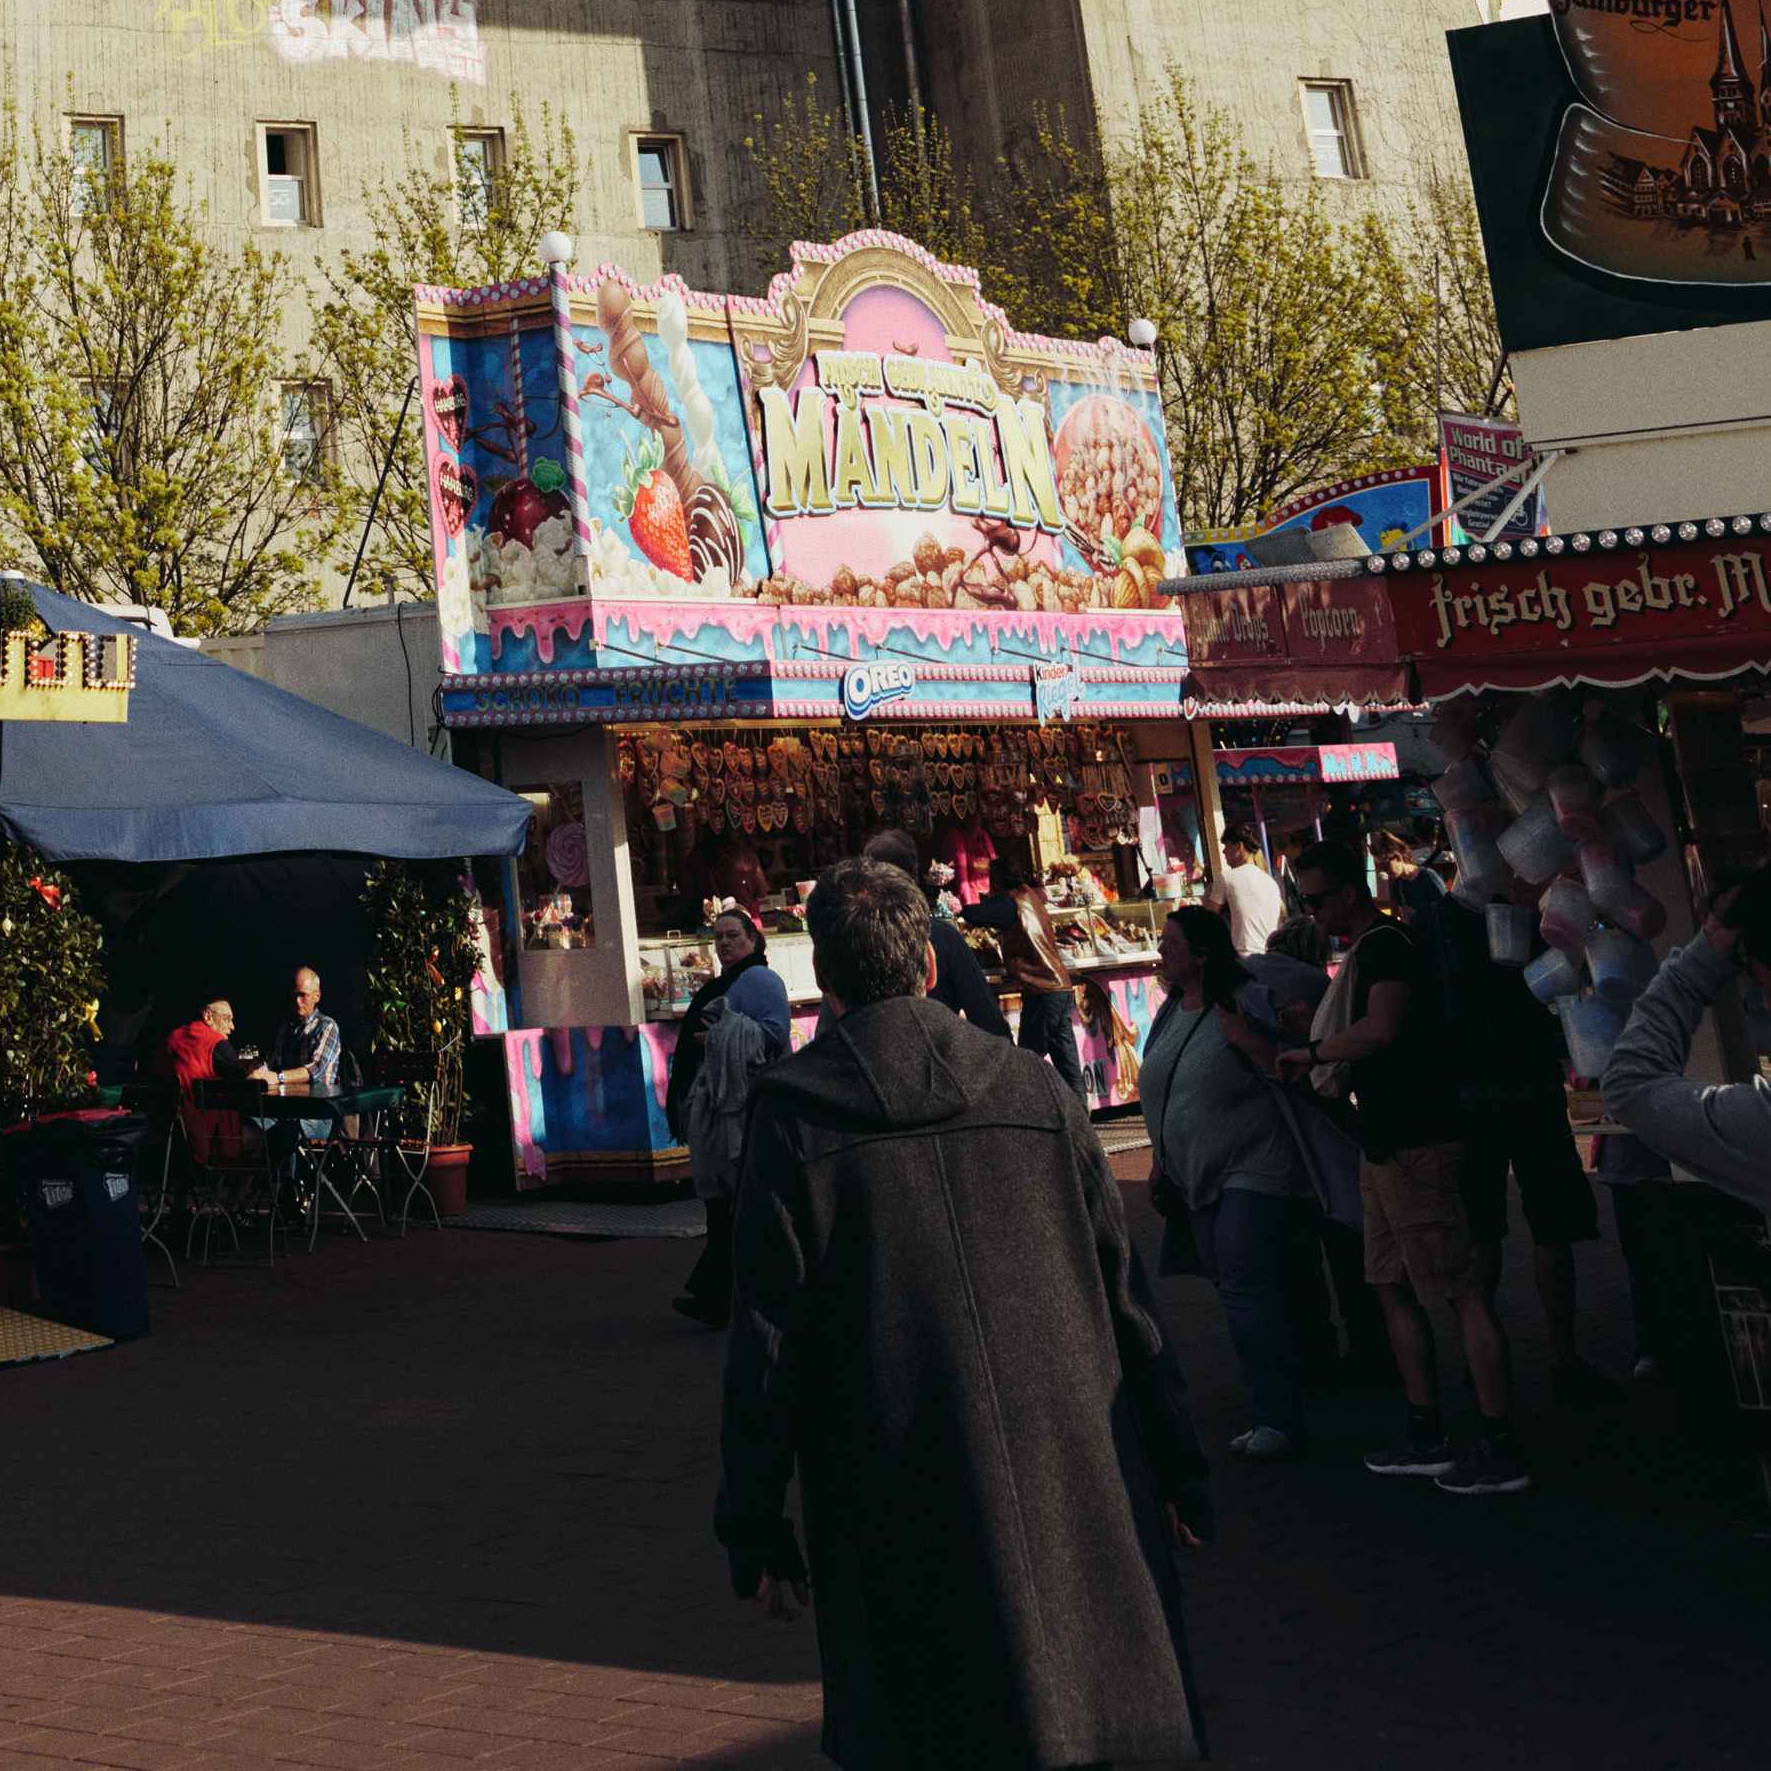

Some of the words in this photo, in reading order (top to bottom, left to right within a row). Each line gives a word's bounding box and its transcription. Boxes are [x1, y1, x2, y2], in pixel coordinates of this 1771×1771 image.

[761, 386, 1066, 532] MANDELN
[1451, 426, 1496, 454] World
[1501, 436, 1524, 460] of
[1583, 551, 1708, 627] gebr.
[1299, 591, 1360, 653] Popcorn
[475, 683, 581, 712] SCHOKO
[848, 664, 914, 704] OREO
